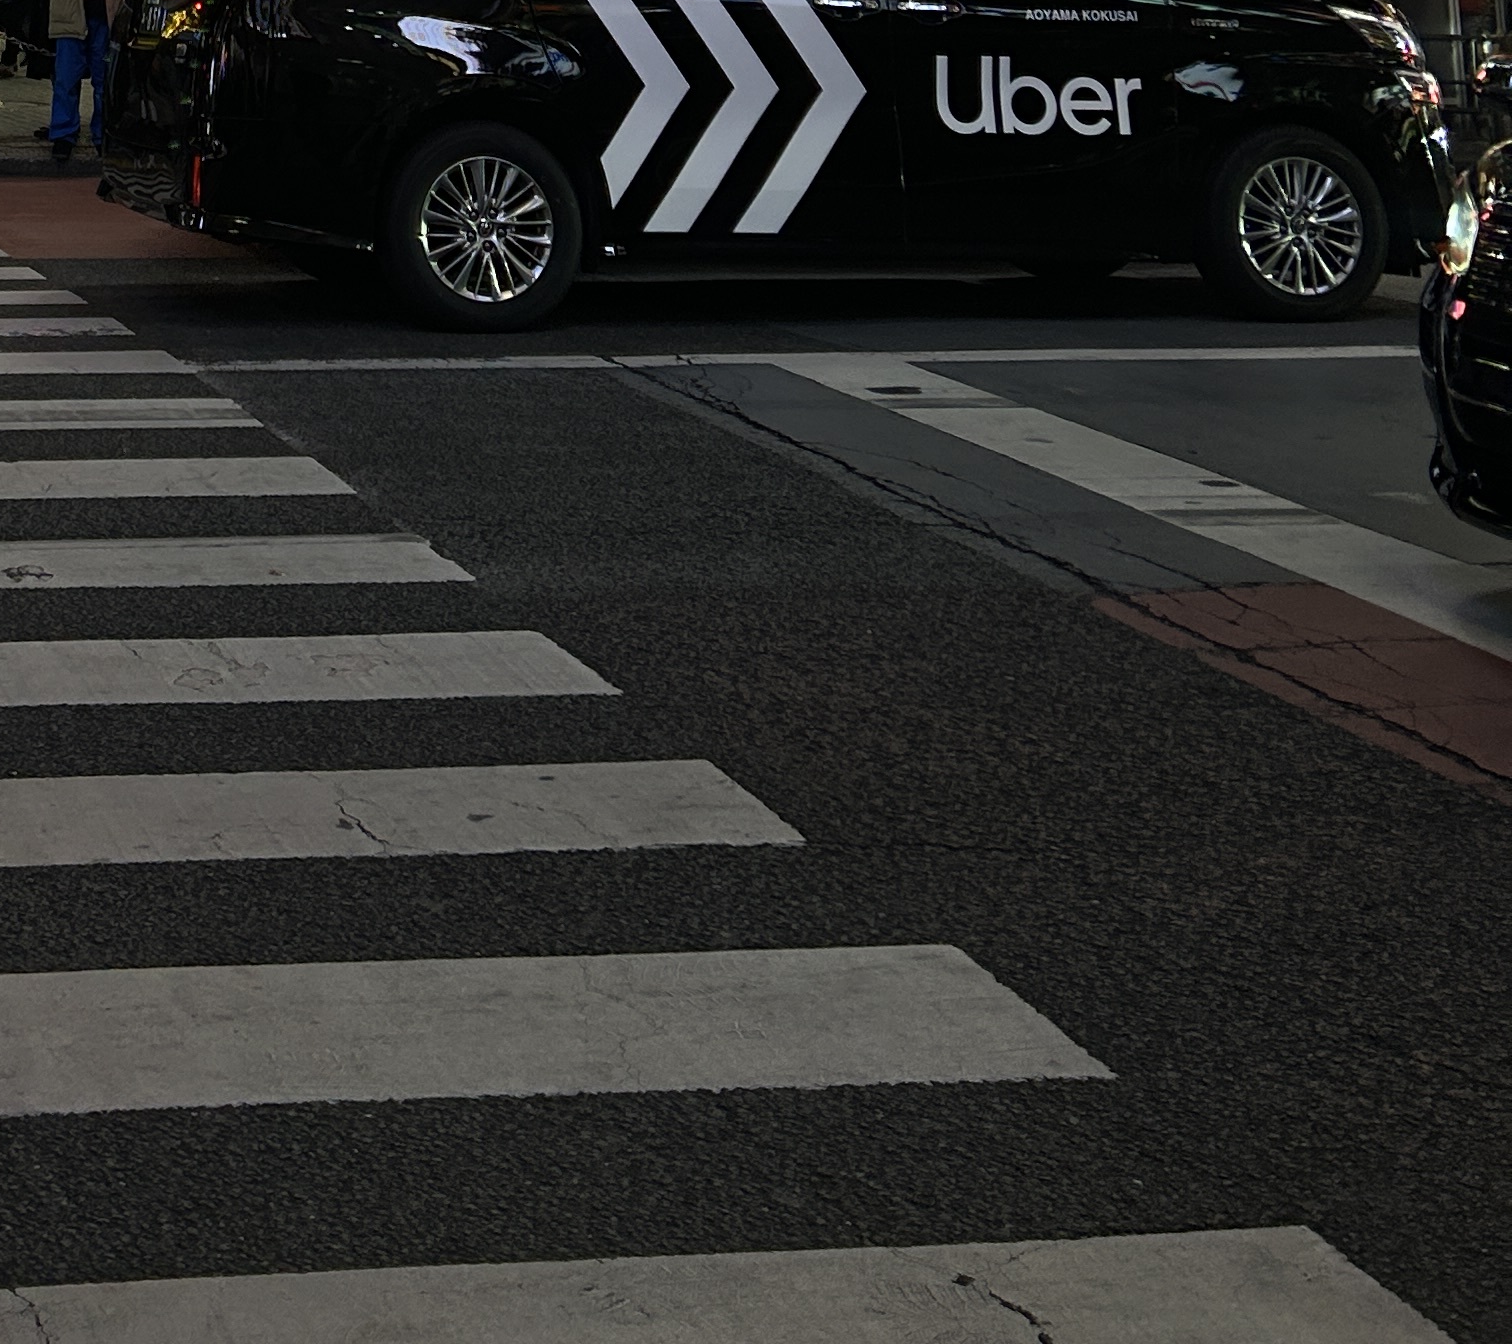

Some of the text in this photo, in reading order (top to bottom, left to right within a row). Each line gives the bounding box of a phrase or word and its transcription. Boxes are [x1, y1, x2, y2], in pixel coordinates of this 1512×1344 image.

[1025, 9, 1139, 22] AOYAMA KOKUSAI
[935, 55, 1143, 136] Uber
